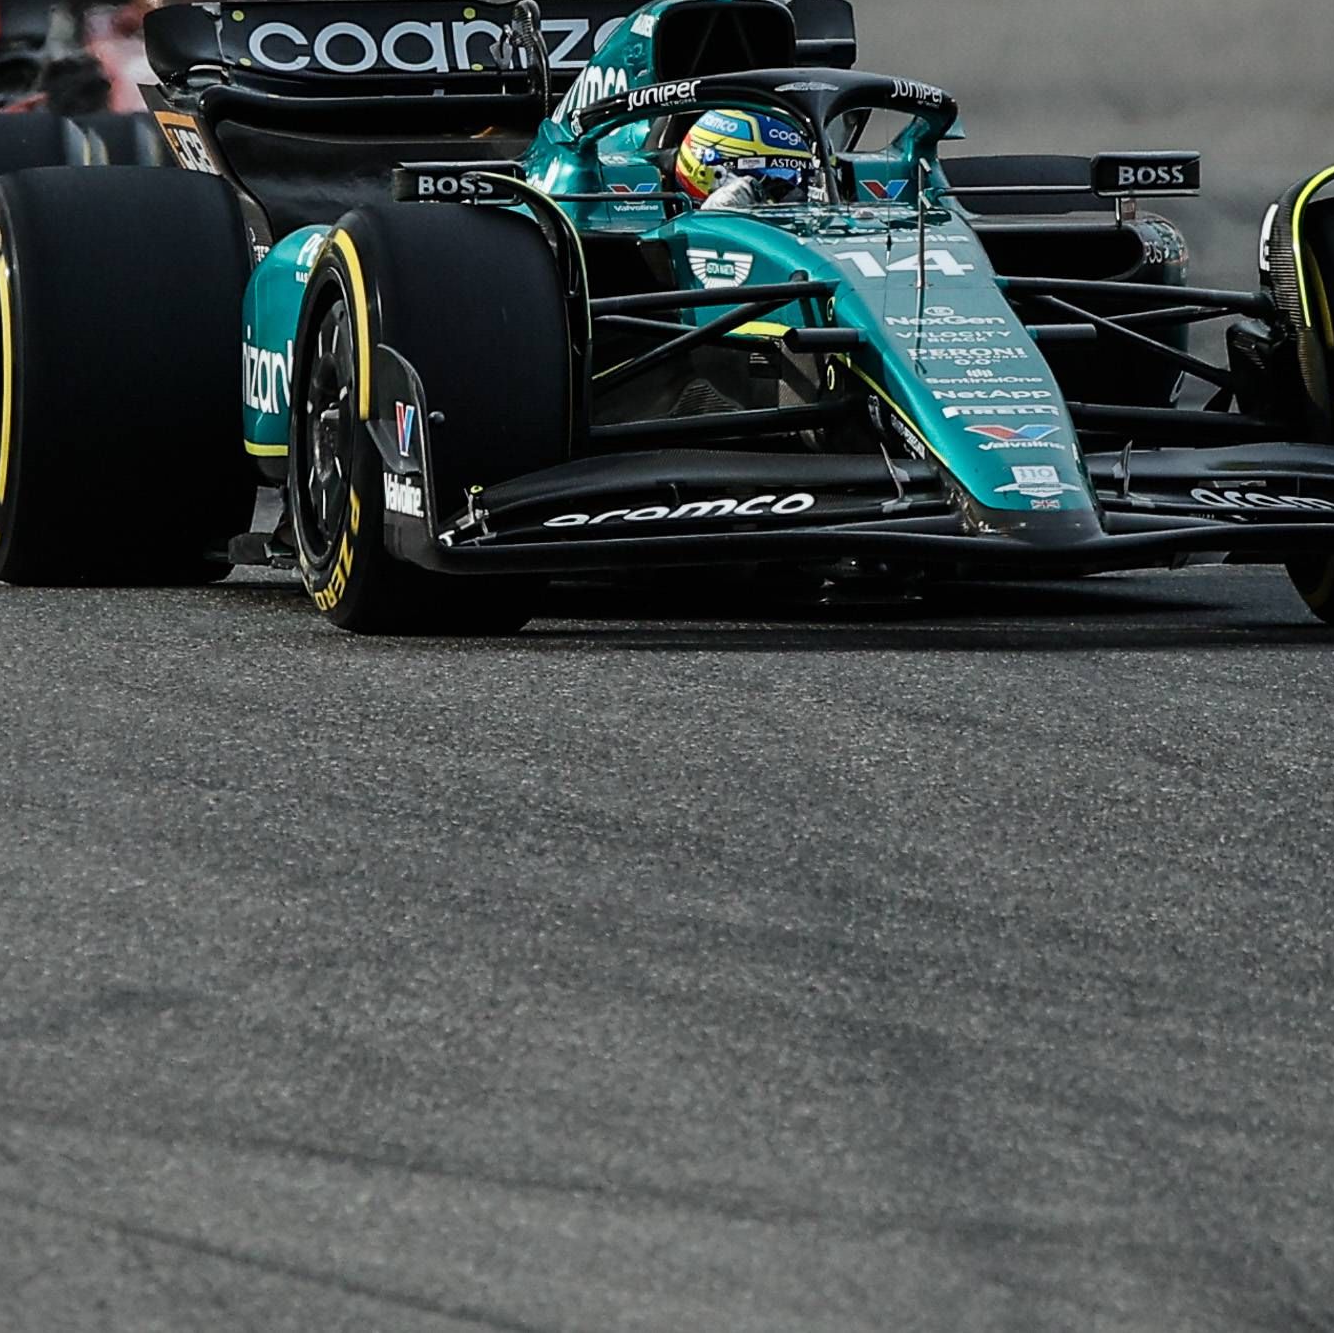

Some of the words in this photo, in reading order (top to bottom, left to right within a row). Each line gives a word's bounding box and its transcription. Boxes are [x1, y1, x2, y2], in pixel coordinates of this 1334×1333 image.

[769, 157, 808, 170] ASTON
[1118, 165, 1185, 186] BOSS
[418, 175, 494, 196] BOSS
[613, 203, 660, 212] Valvoline
[833, 249, 975, 278] 14
[884, 315, 1006, 326] NexGen
[906, 347, 1026, 358] PERONI
[931, 389, 1052, 400] NetApp
[542, 492, 816, 528] aramco
